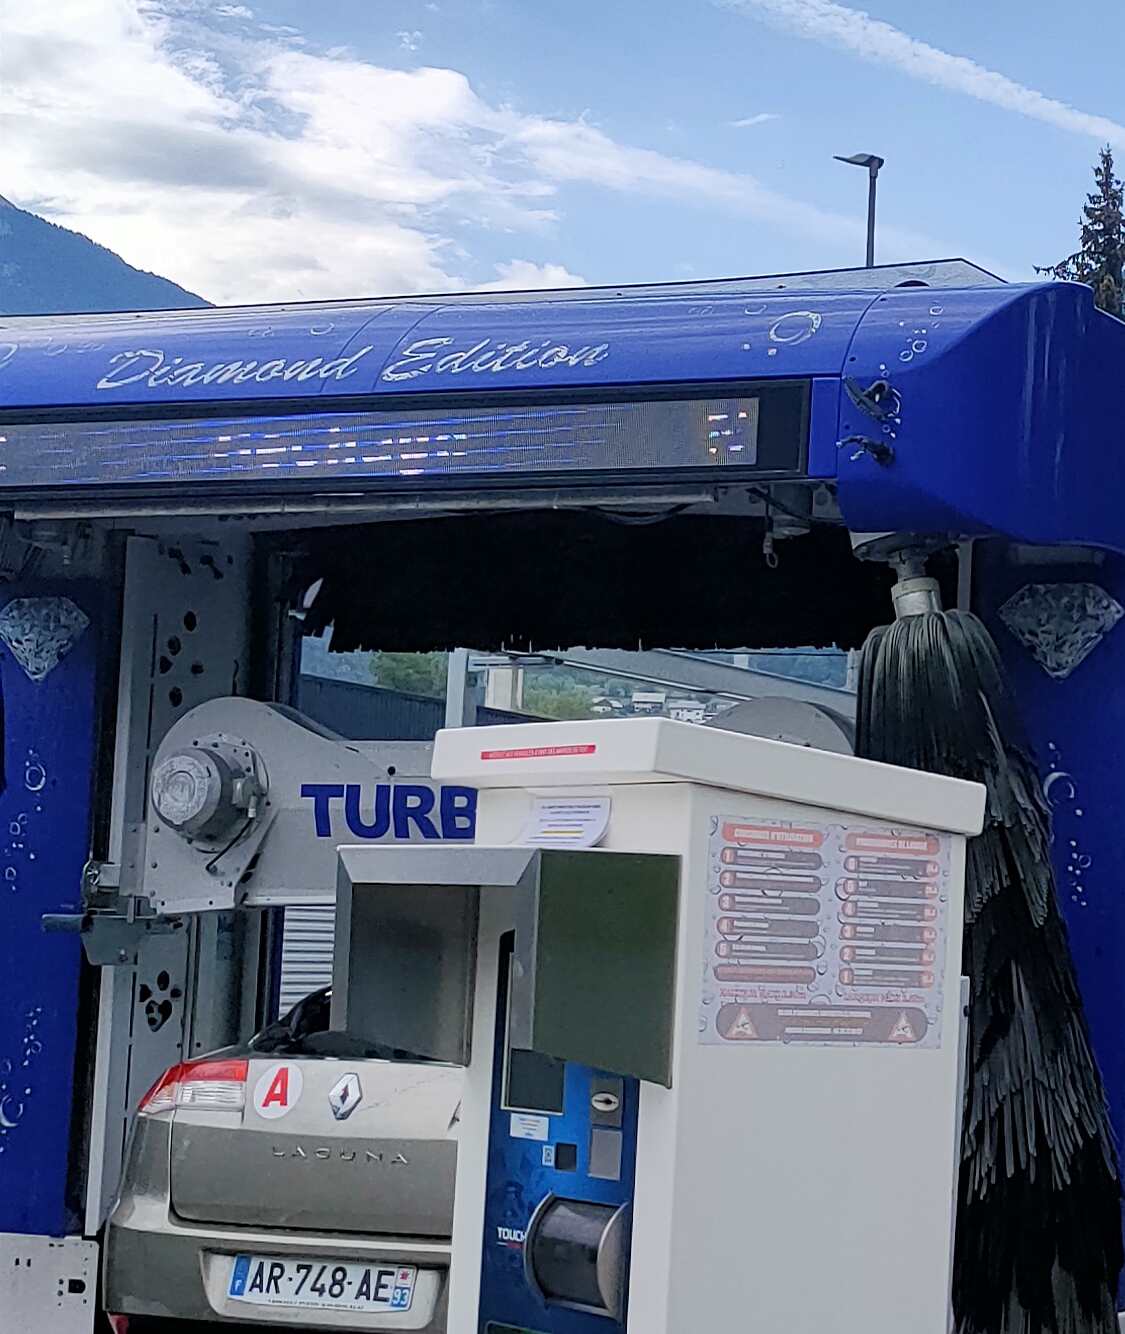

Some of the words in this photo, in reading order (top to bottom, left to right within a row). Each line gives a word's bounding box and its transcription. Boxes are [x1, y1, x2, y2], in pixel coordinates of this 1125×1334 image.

[97, 345, 374, 390] Diamond
[381, 336, 609, 383] Edition
[261, 1067, 289, 1108] A
[272, 1144, 409, 1165] LAGUNA
[234, 1280, 241, 1291] F
[248, 1261, 396, 1303] AR-748-AE
[392, 1288, 410, 1306] 93
